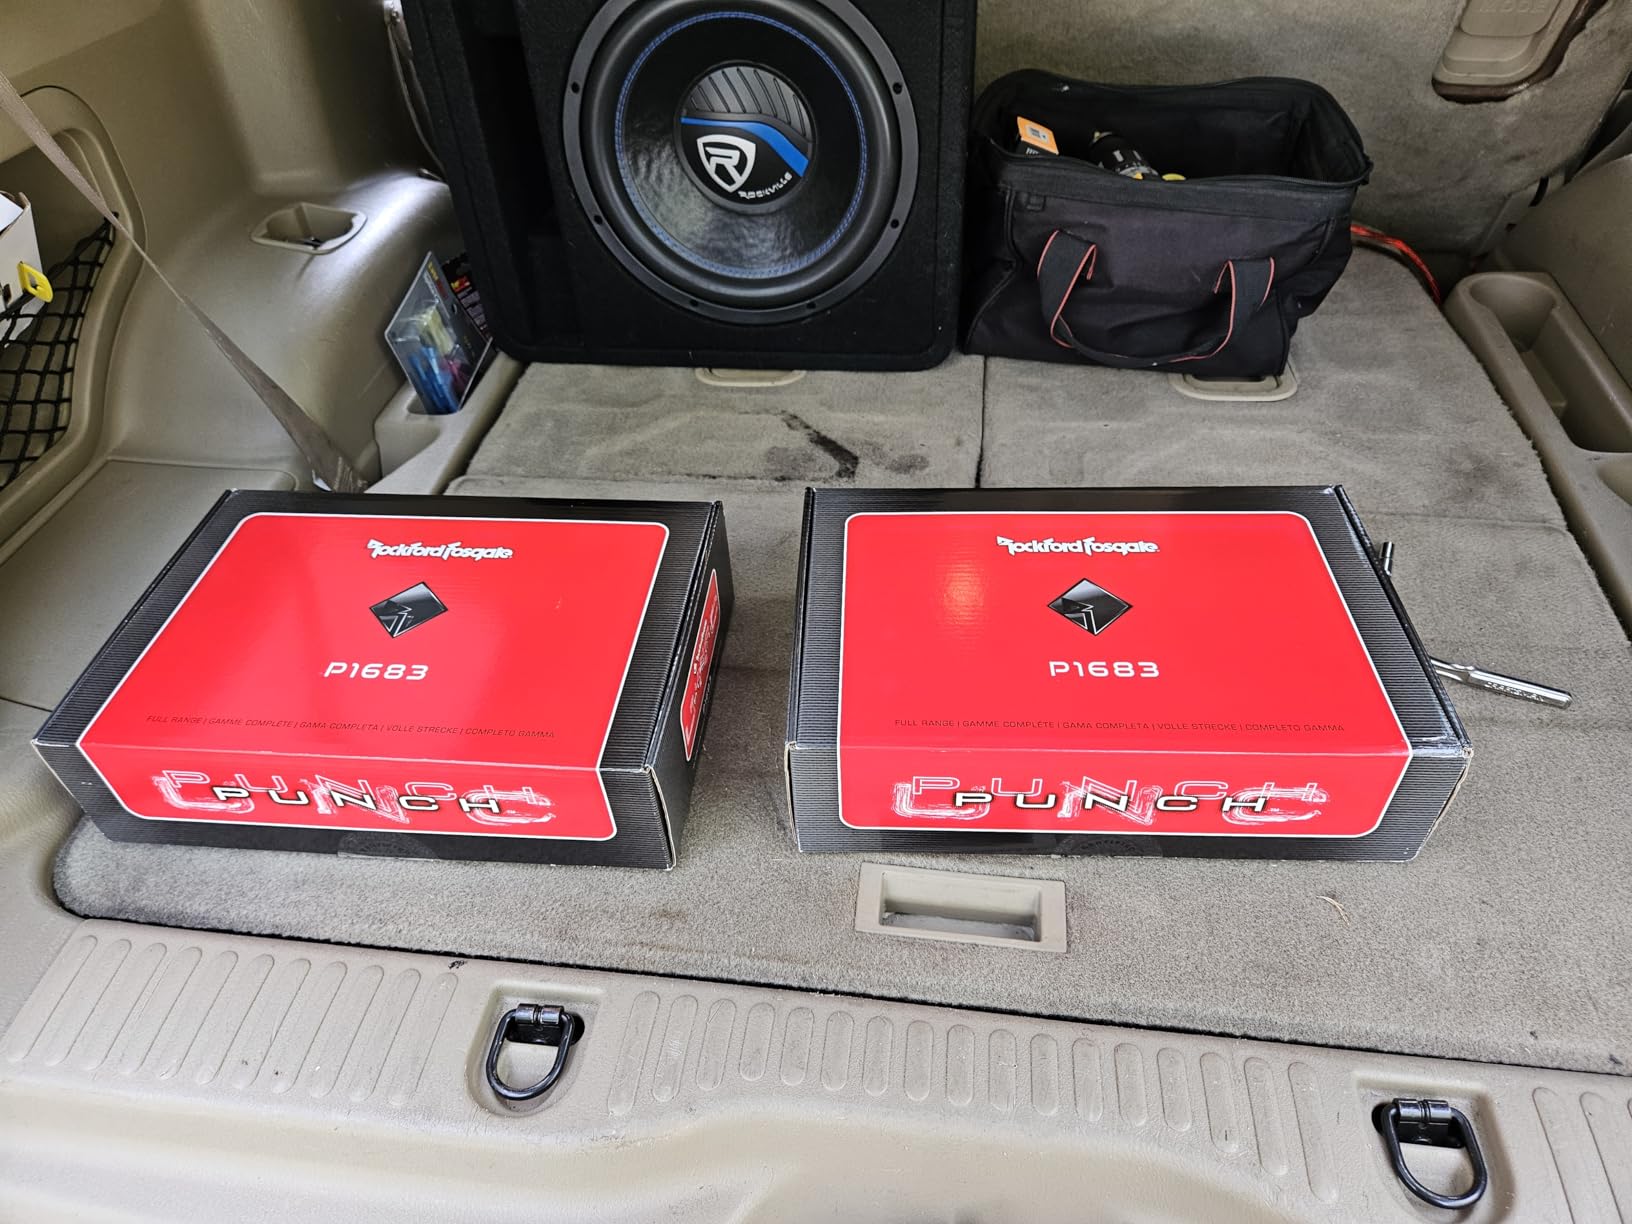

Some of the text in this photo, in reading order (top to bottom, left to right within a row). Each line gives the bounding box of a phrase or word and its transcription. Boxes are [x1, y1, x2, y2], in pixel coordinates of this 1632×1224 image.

[323, 661, 429, 681] P1683
[1048, 660, 1160, 678] P1683
[146, 715, 168, 723] FULL
[170, 716, 203, 724] RANGE
[208, 718, 244, 726] GAMME
[299, 721, 327, 729] GAMA
[328, 722, 379, 731] COMPLETA
[386, 724, 415, 733] VOLLE
[416, 725, 459, 735] STRECKE
[464, 727, 516, 737] COMPLETO
[517, 730, 556, 739] GAMMA
[894, 719, 918, 727] FULL
[921, 719, 955, 727] RANGE
[962, 720, 1000, 728] GAMME
[1062, 721, 1093, 729] GAMA
[1095, 721, 1150, 730] COMPLETA
[1157, 722, 1192, 731] VOLLE
[1191, 722, 1239, 731] STRECKE
[1245, 723, 1301, 732] COMPLETO
[1303, 724, 1345, 733] GAMMA
[211, 785, 501, 815] PUNCH
[954, 791, 1267, 813] PUNCH
